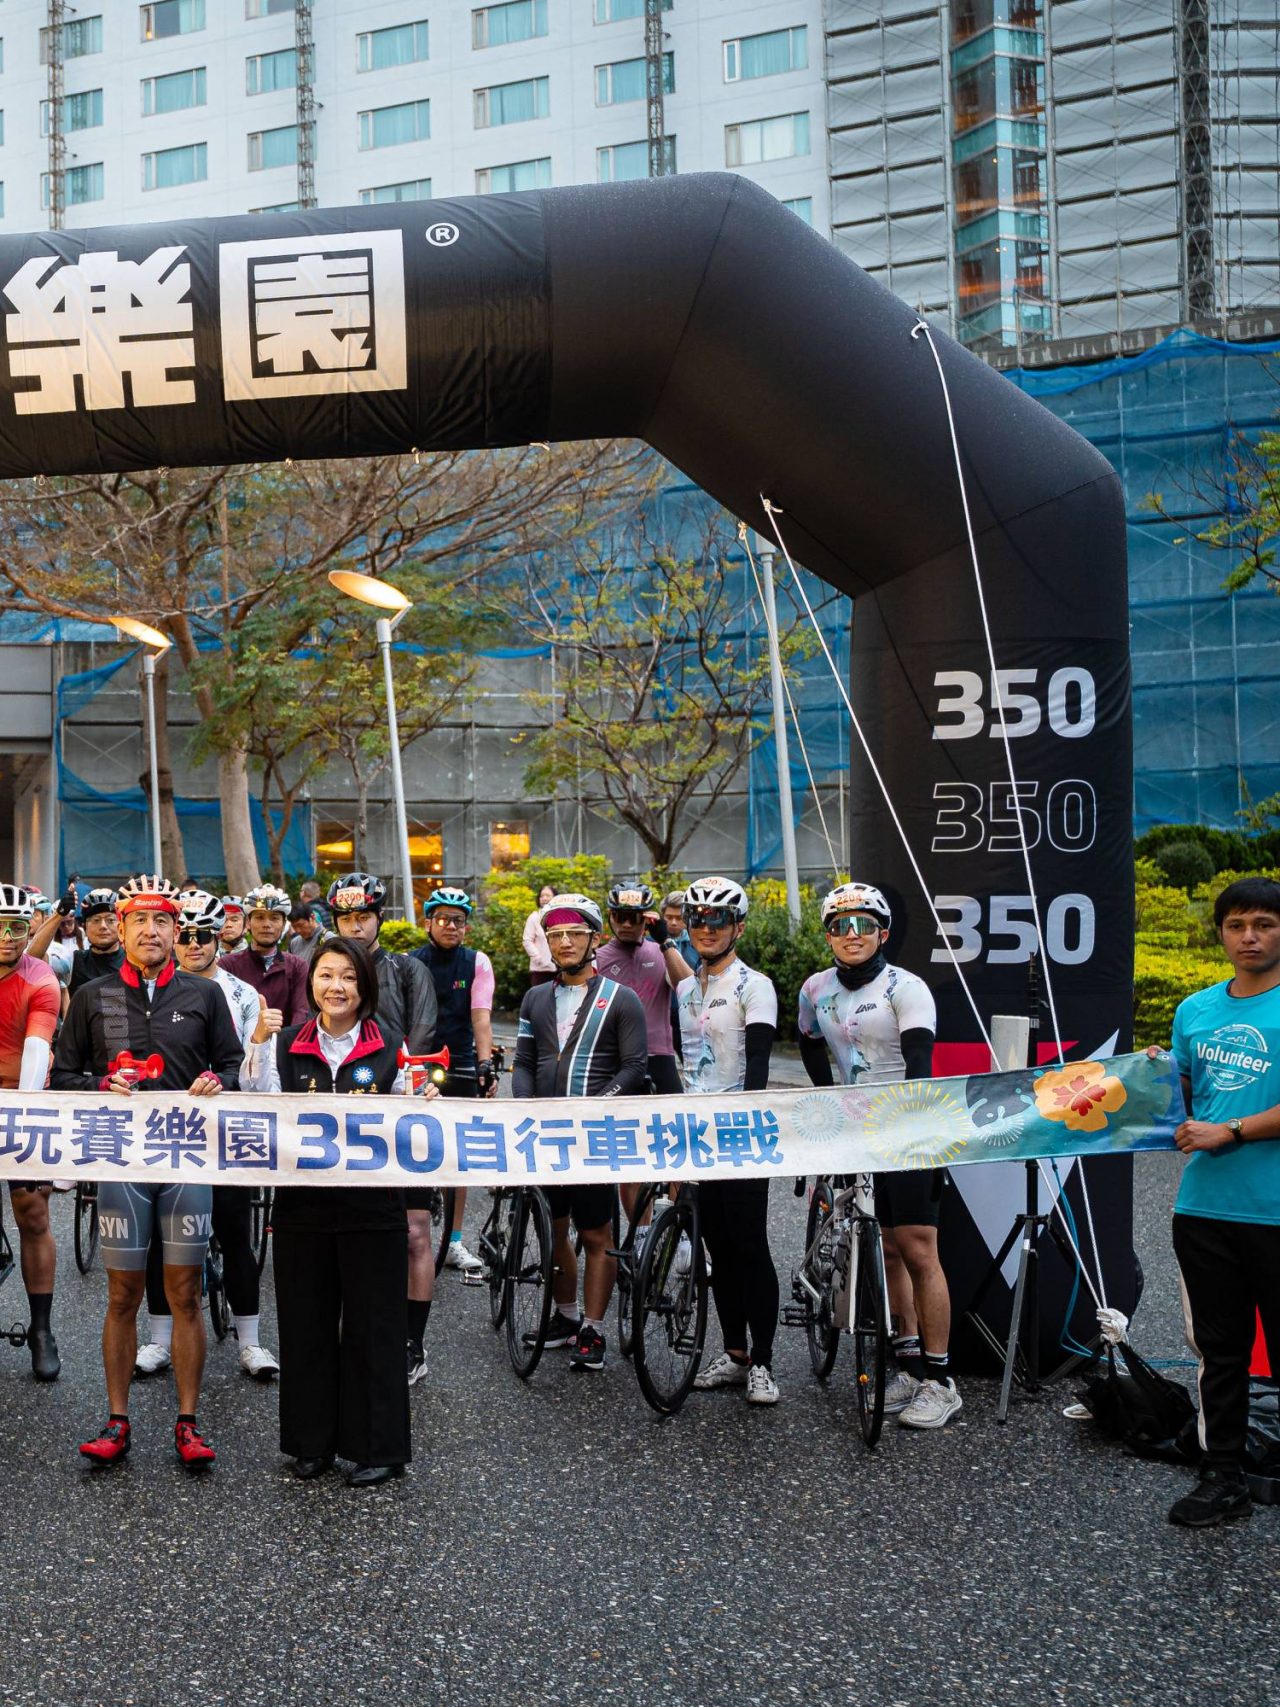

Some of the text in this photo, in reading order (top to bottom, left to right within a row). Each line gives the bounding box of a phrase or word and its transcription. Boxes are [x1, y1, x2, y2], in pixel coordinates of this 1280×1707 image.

[932, 666, 1097, 740] 350
[931, 778, 1097, 853] 350
[134, 898, 163, 907] Santini
[929, 892, 1096, 965] 350
[1196, 1042, 1272, 1074] Volunteer
[99, 1215, 129, 1239] SYN
